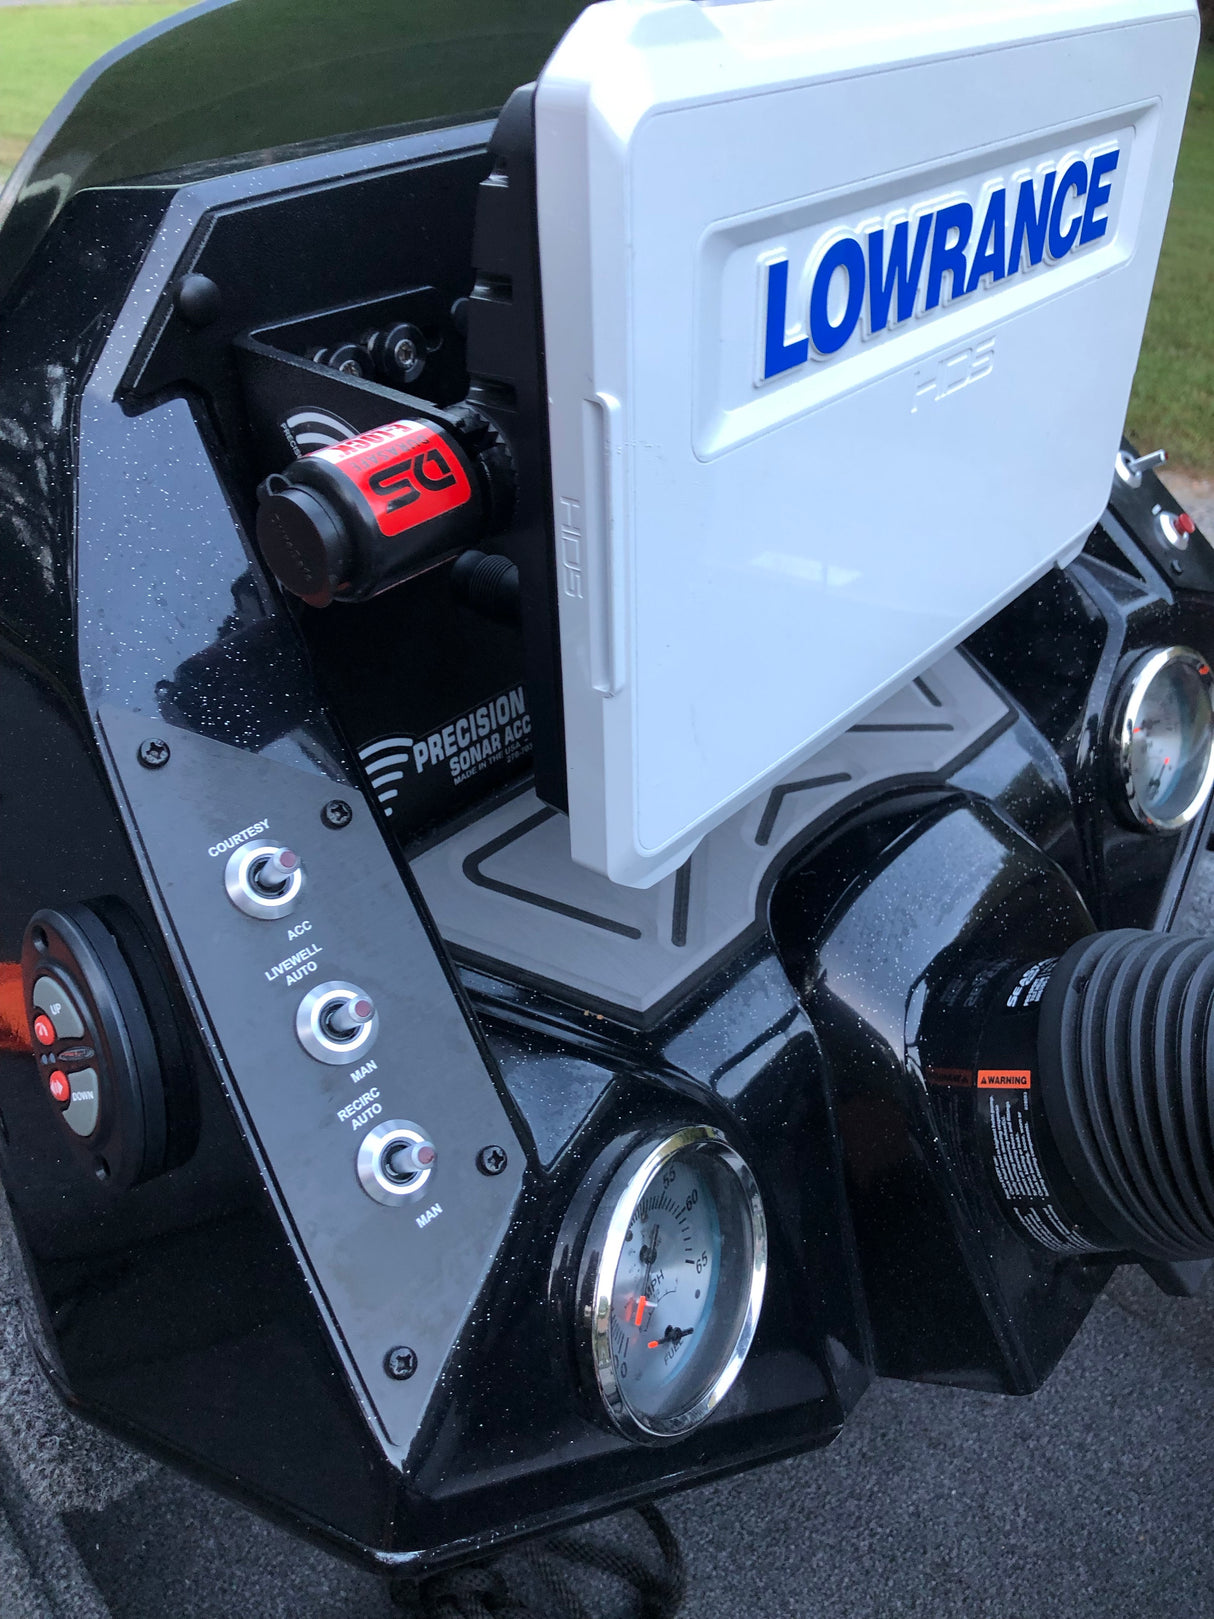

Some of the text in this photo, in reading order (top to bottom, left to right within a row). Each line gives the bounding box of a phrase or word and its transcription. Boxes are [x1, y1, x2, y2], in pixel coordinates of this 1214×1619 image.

[763, 148, 1121, 381] LOWRANCE
[350, 434, 432, 473] DURASAFE
[368, 447, 458, 515] DS
[559, 495, 584, 600] HDS
[412, 686, 527, 775] PRECISION
[449, 732, 502, 777] SONAR
[453, 766, 478, 786] MADE
[478, 760, 487, 771] IN
[488, 751, 504, 765] THE
[505, 740, 521, 755] USA
[207, 818, 271, 858] COURTESY
[287, 920, 313, 941] ACC
[264, 943, 323, 981] LIVEWELL
[285, 961, 318, 987] AUTO
[49, 1002, 62, 1016] UP
[350, 1059, 378, 1083] MAN
[987, 1076, 1028, 1086] WARNING
[72, 1091, 94, 1102] DOWN
[336, 1087, 381, 1122] RECIRC
[351, 1103, 383, 1131] AUTO
[663, 1165, 676, 1190] 55
[686, 1188, 698, 1212] 60
[415, 1202, 443, 1229] MAN
[696, 1250, 708, 1275] 65
